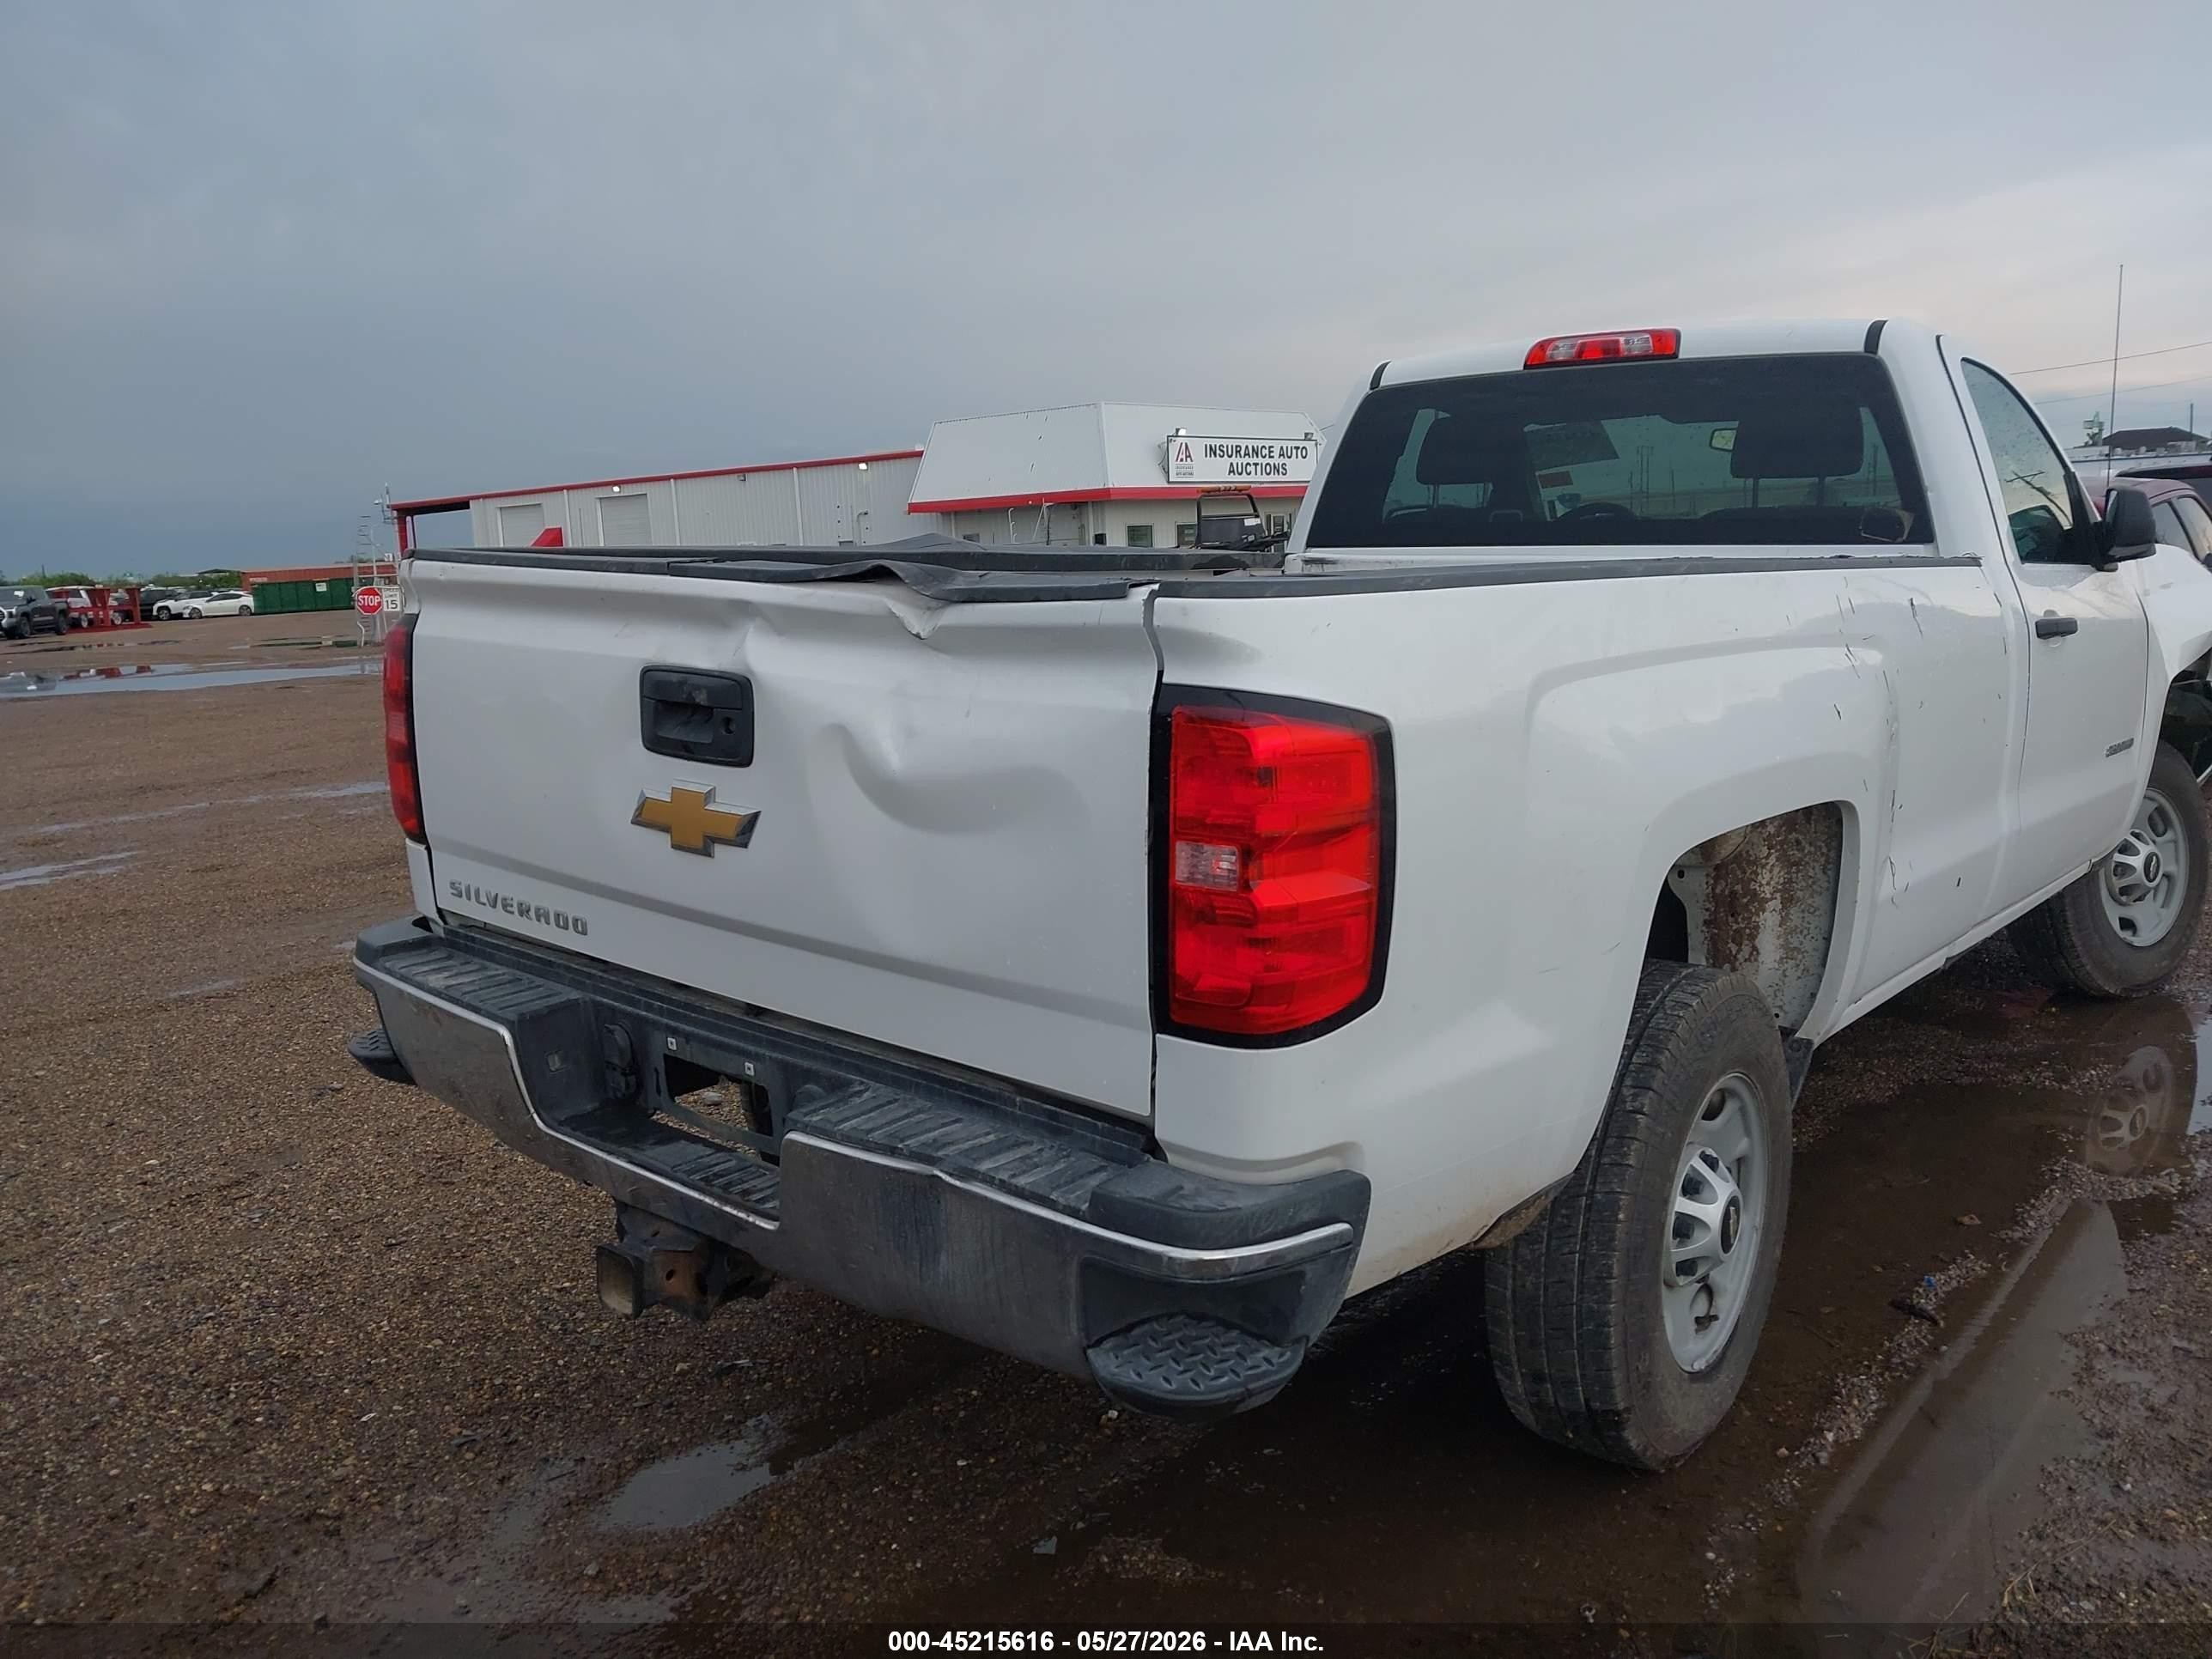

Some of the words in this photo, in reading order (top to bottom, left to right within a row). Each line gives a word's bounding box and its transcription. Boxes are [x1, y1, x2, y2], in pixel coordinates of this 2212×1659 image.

[1204, 443, 1274, 459] INSURANCE
[1278, 445, 1308, 459] AUTO
[1227, 461, 1288, 477] AUCTIONS
[357, 595, 380, 606] STOP
[386, 599, 398, 610] 15
[448, 879, 588, 936] SILVERADO
